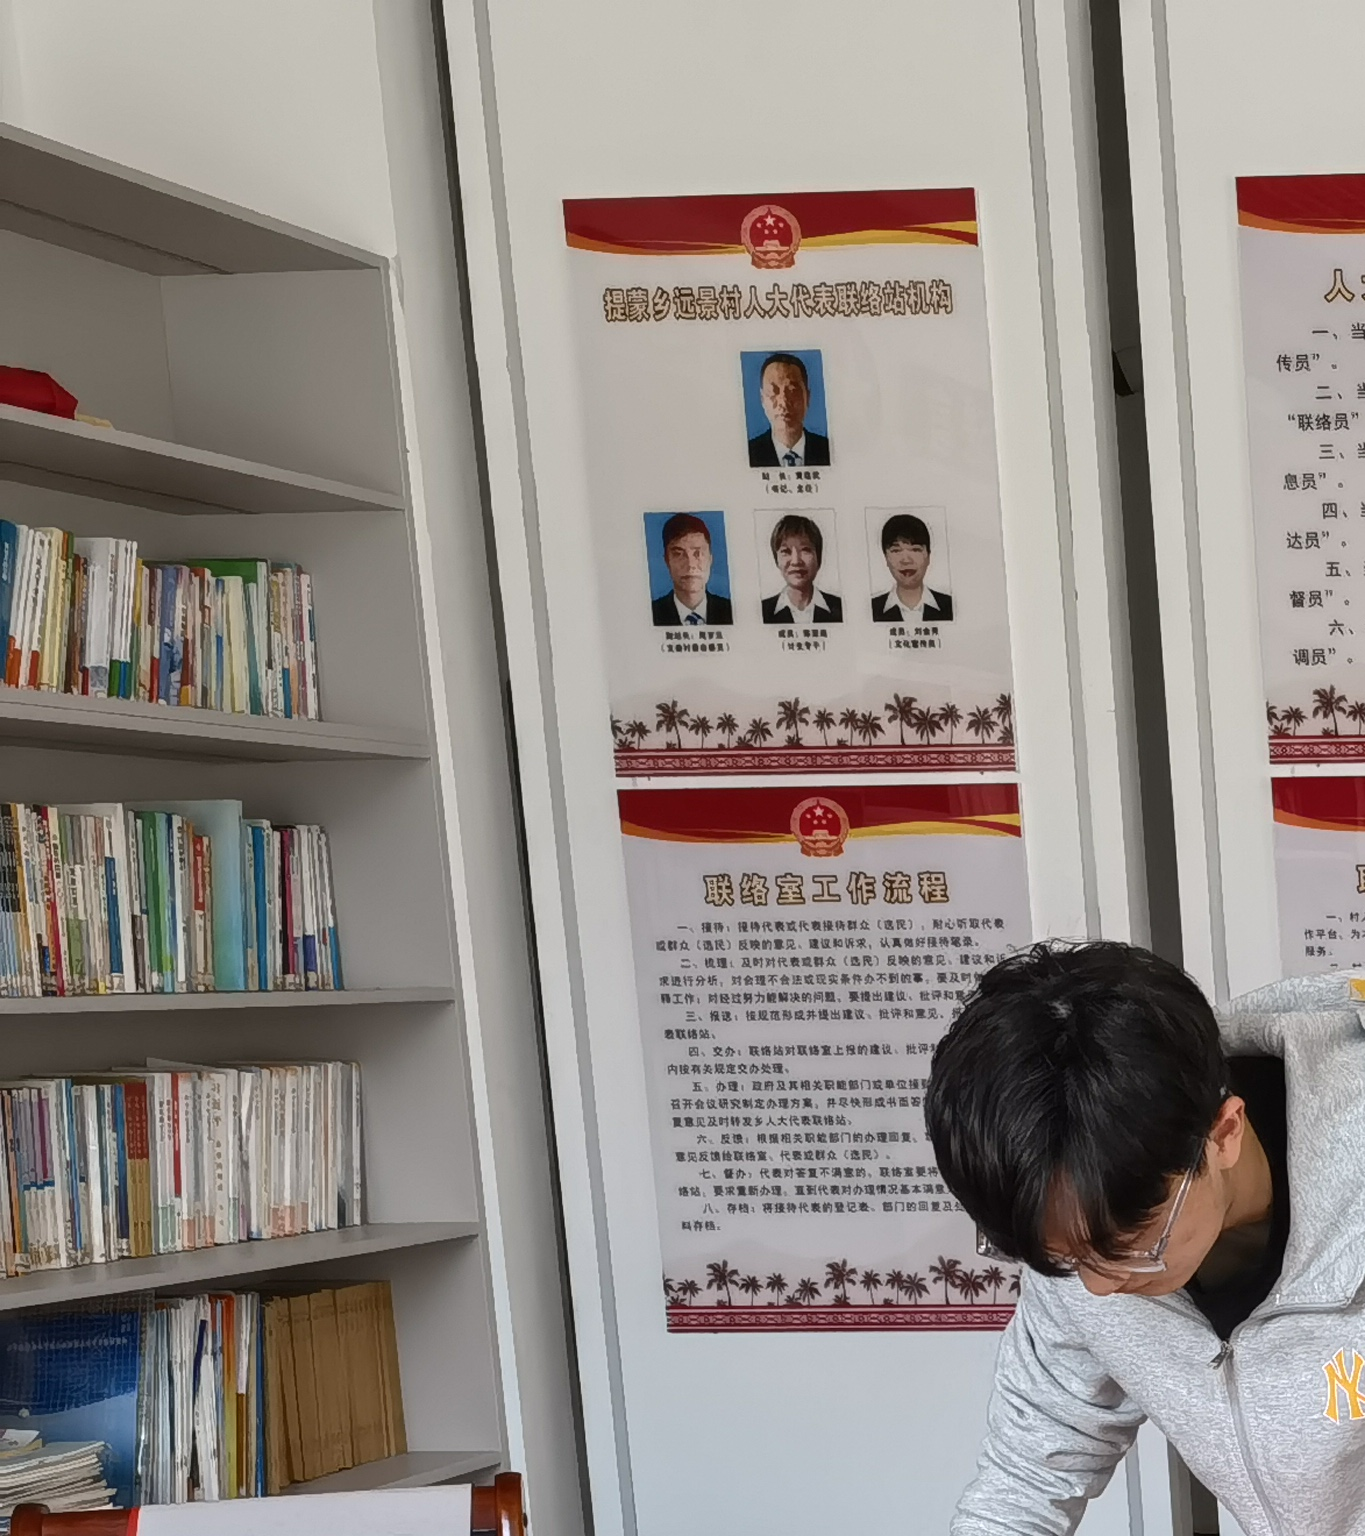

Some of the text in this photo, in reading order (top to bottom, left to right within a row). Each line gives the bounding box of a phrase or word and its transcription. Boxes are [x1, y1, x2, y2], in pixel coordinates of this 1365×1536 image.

[602, 279, 954, 323] 提蒙乡远景村人大代表联络站机构
[702, 871, 949, 906] 联络室工作流程
